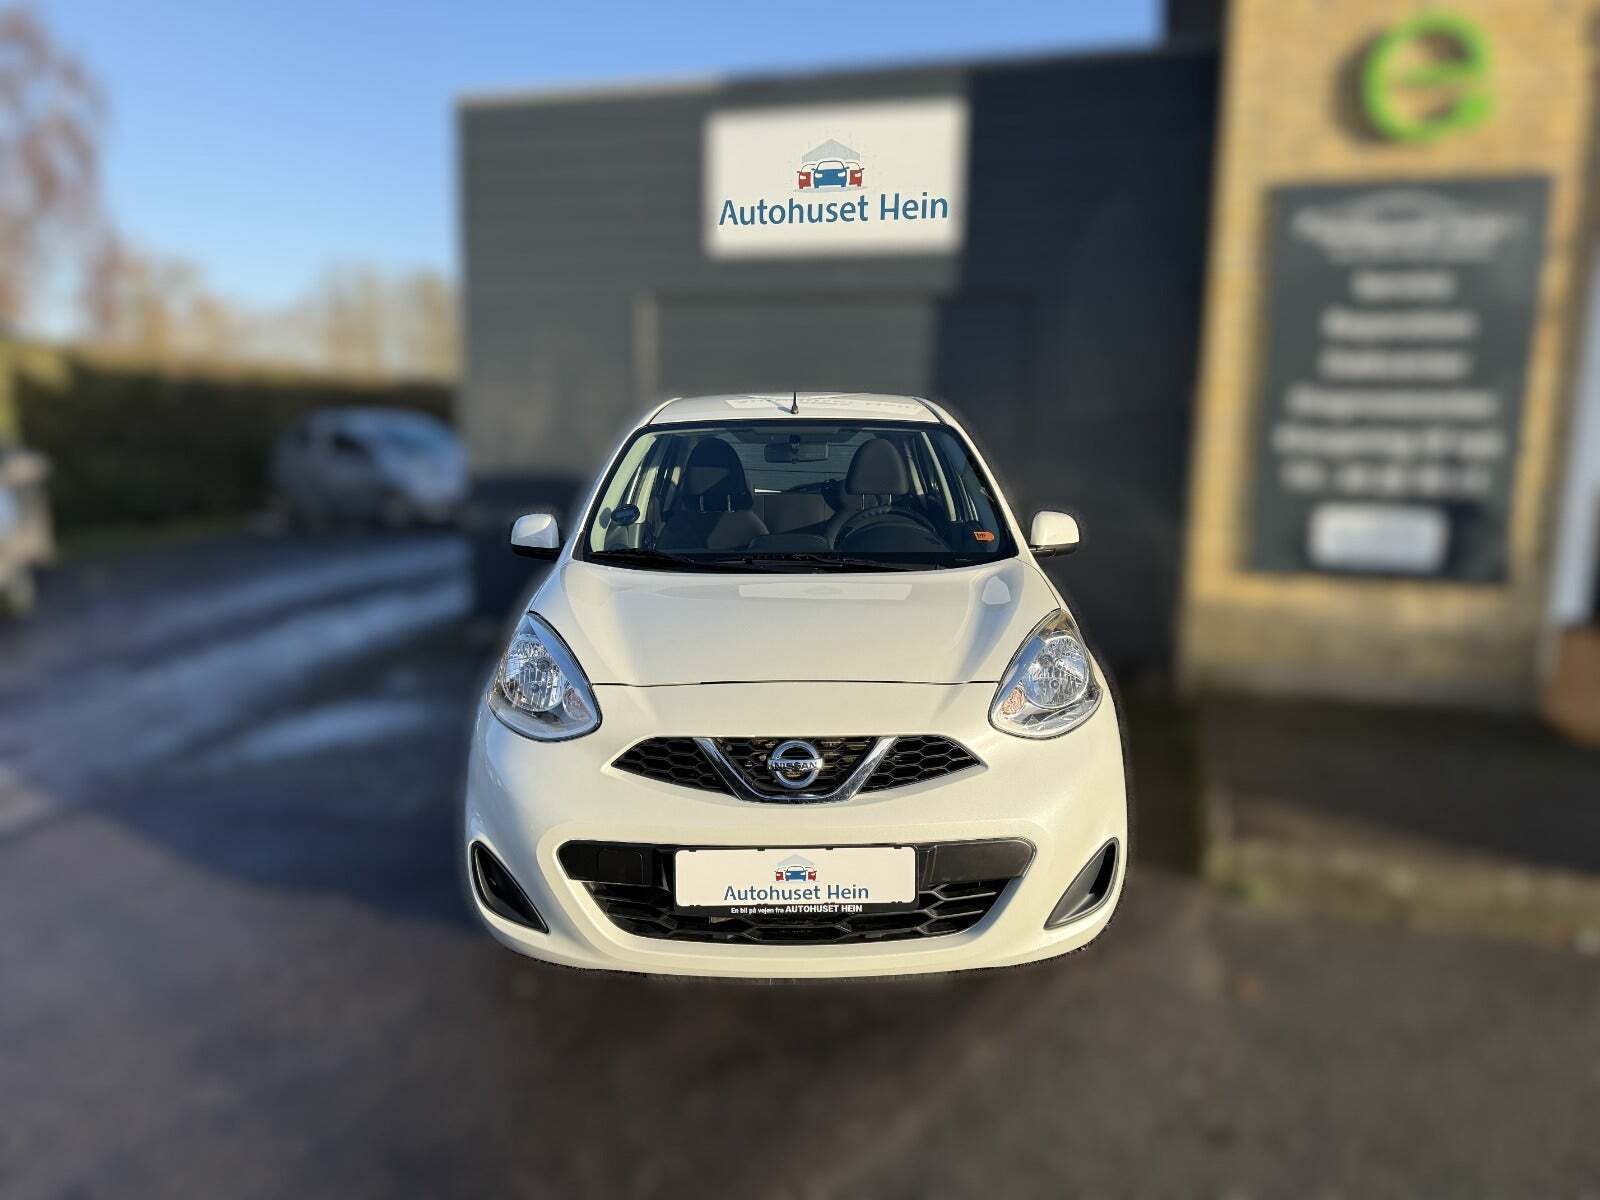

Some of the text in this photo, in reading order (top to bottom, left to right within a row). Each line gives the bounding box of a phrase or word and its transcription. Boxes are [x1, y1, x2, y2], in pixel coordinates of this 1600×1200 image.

[719, 192, 948, 225] Autohuset Hein
[774, 761, 817, 770] NISSAN
[724, 884, 869, 901] Autohuset Hein
[757, 907, 774, 915] vejen
[785, 905, 839, 913] AUTOHUSET
[841, 905, 863, 913] HEIN
